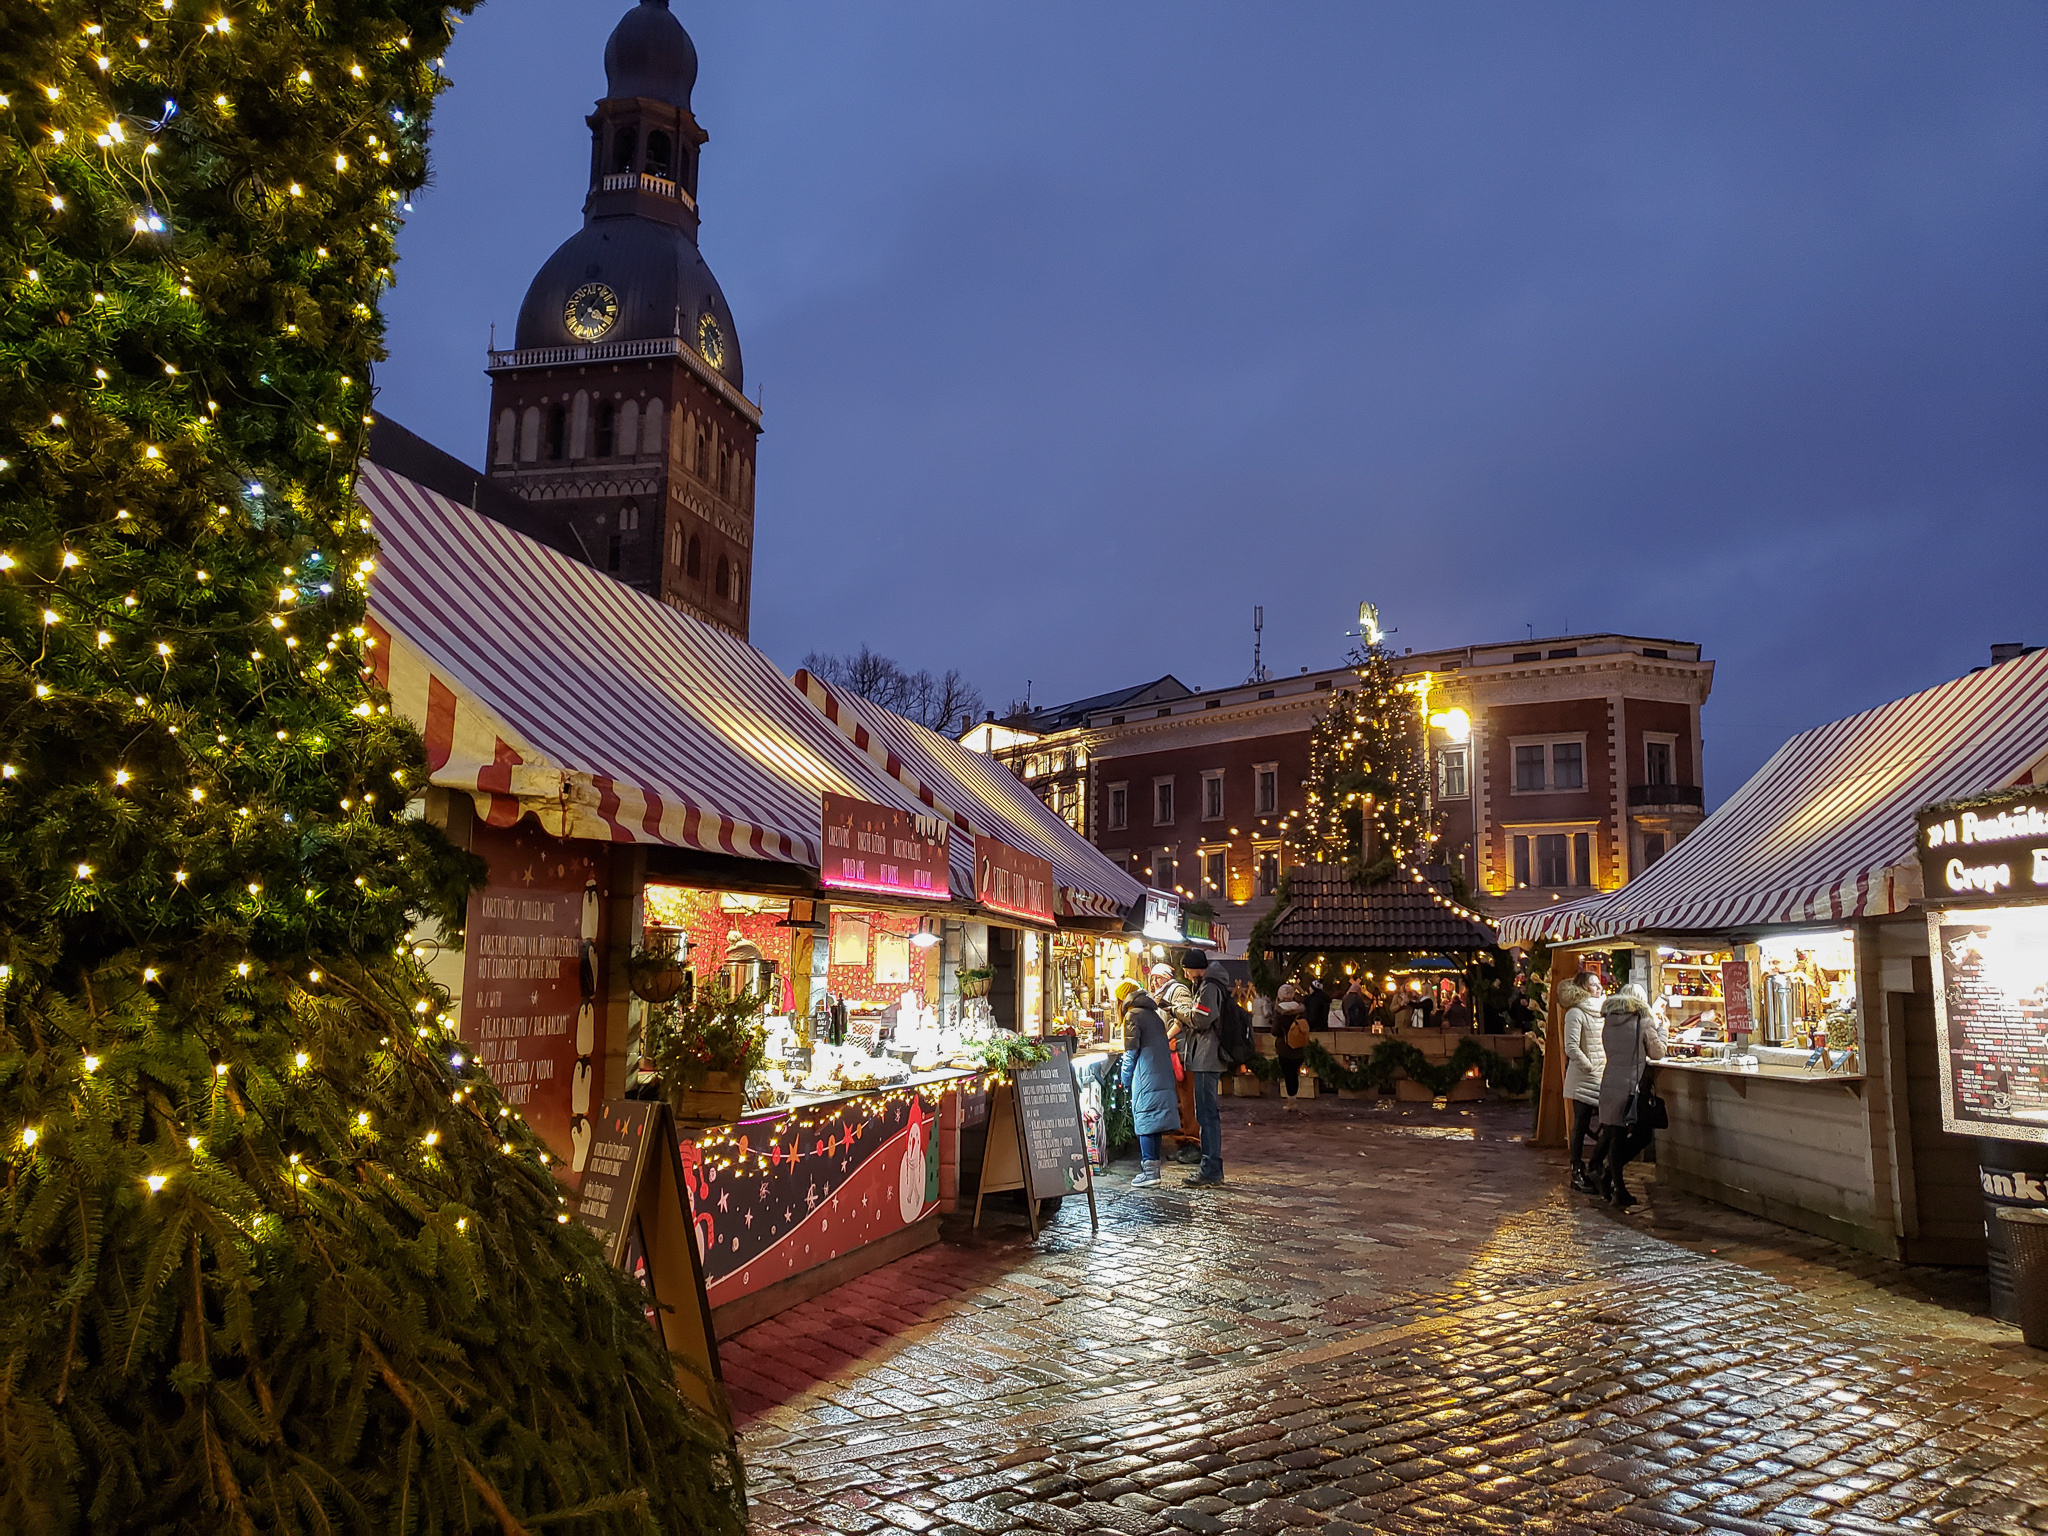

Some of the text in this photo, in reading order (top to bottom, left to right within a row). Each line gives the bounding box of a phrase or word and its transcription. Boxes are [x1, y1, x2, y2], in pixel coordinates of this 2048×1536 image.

[993, 866, 1044, 914] STREET FOOD MARKET
[482, 896, 515, 920] KARSTVĪNS
[522, 900, 540, 921] MULLED
[542, 902, 555, 922] WINE
[480, 934, 508, 956] KARSTAIS
[528, 936, 538, 956] VAI
[478, 958, 561, 979] HOT CURRANT OR APPLE DRINK
[476, 991, 483, 1008] AR
[490, 991, 502, 1008] WITH
[480, 1015, 500, 1039] RĪGAS
[501, 1017, 528, 1038] BALZAMU
[534, 1016, 546, 1036] RIGA
[504, 1040, 518, 1060] RUM
[502, 1059, 529, 1084] DEGVĪNU
[536, 1059, 554, 1080] VODKA
[508, 1083, 532, 1105] WHISKEY
[1979, 1164, 2048, 1200] ank
